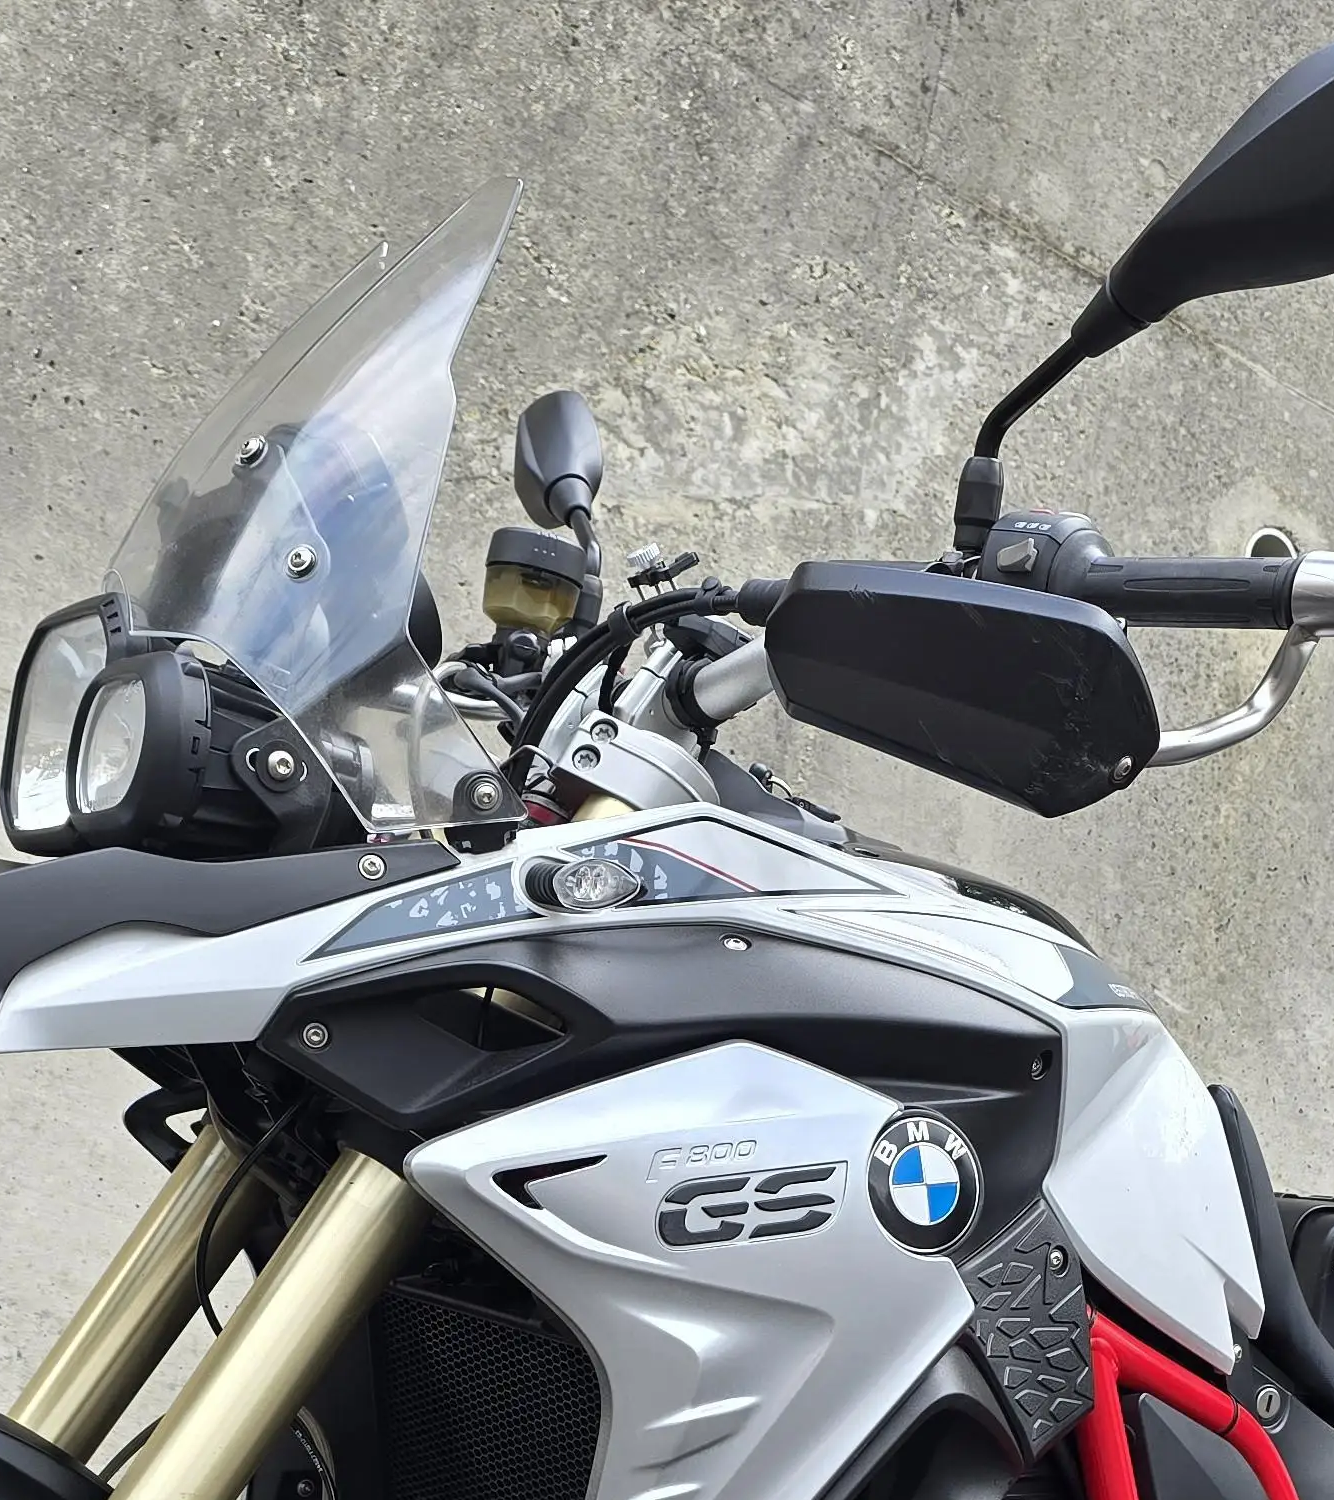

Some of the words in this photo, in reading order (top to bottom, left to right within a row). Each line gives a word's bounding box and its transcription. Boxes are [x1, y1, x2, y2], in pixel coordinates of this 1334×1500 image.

[685, 1139, 758, 1169] 800
[874, 1120, 969, 1165] BMW
[657, 1165, 838, 1248] GS
